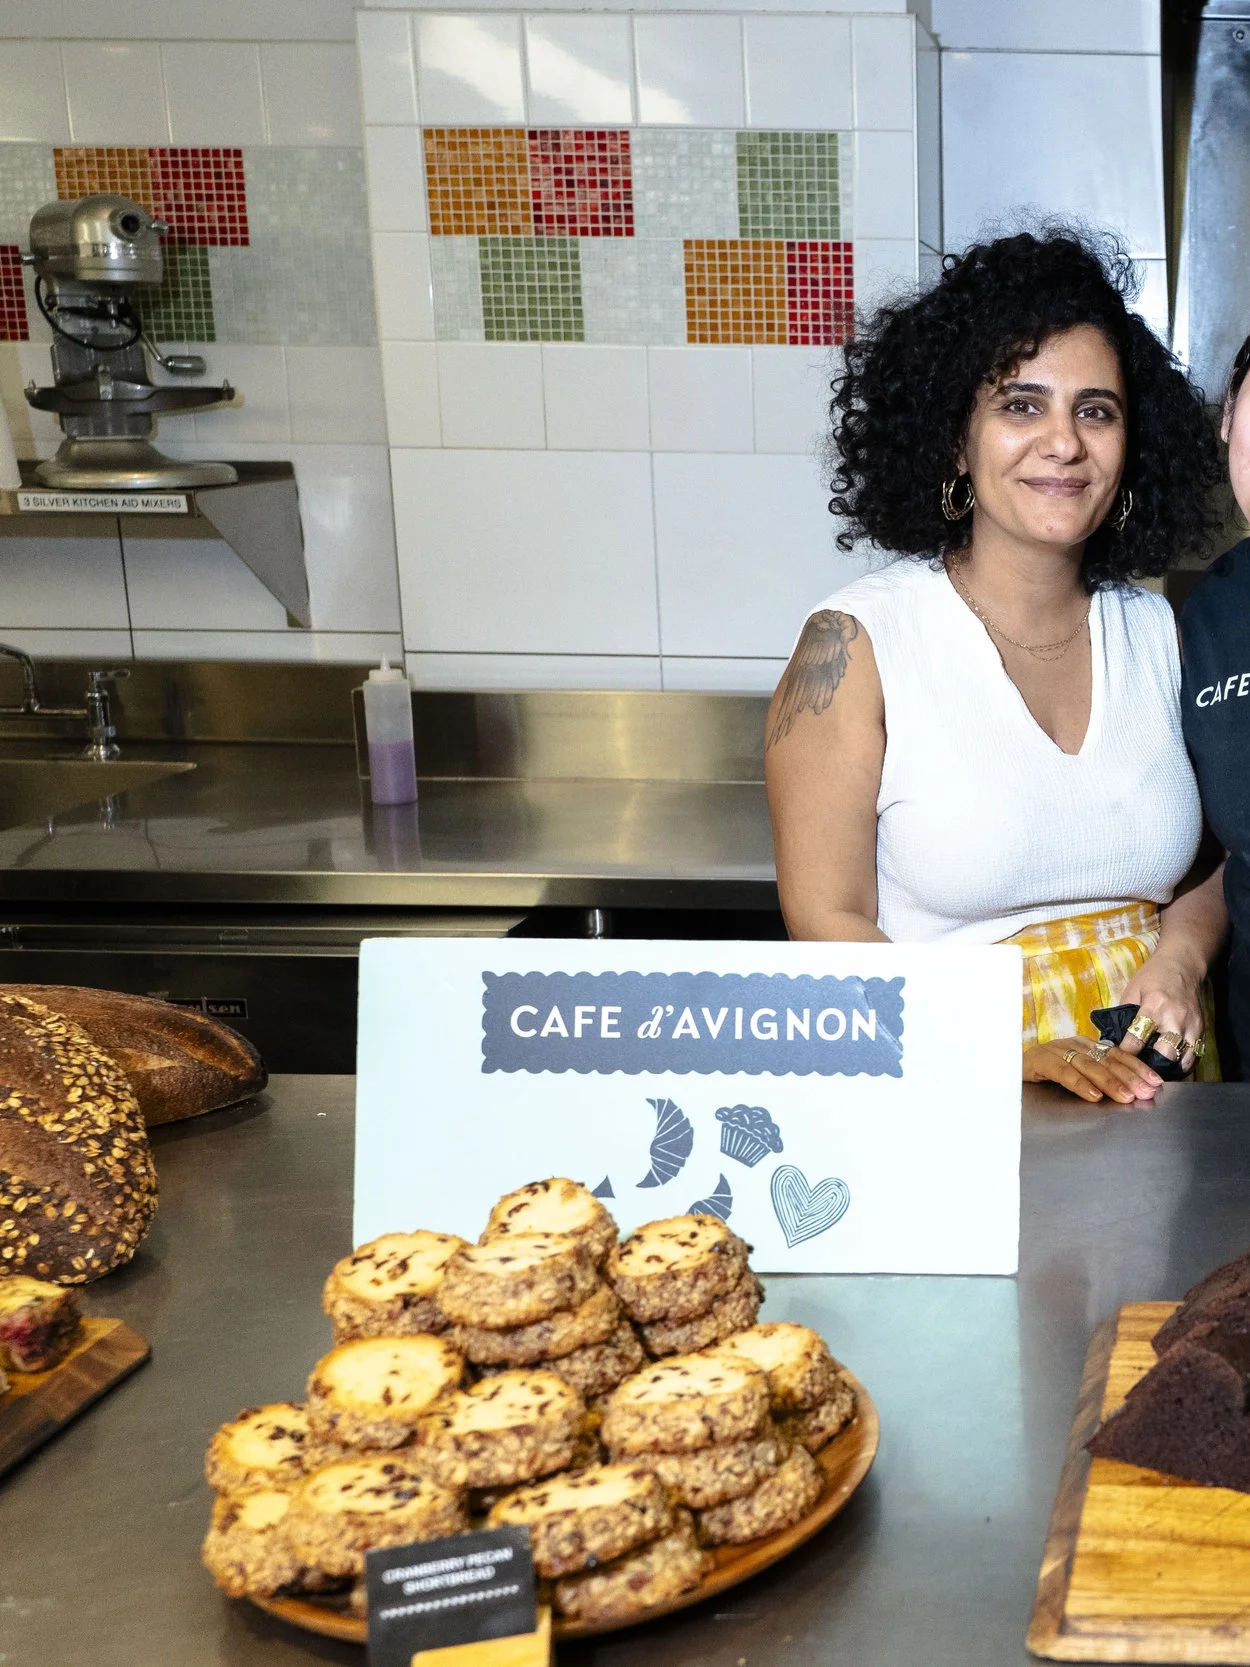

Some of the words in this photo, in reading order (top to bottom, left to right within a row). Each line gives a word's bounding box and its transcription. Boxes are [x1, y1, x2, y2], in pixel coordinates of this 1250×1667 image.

[24, 497, 30, 506] 3
[32, 497, 70, 507] SILVER
[73, 498, 118, 508] KITCHEN
[121, 499, 138, 508] AID
[141, 499, 181, 509] MIXERS
[510, 1005, 622, 1039] CAFE
